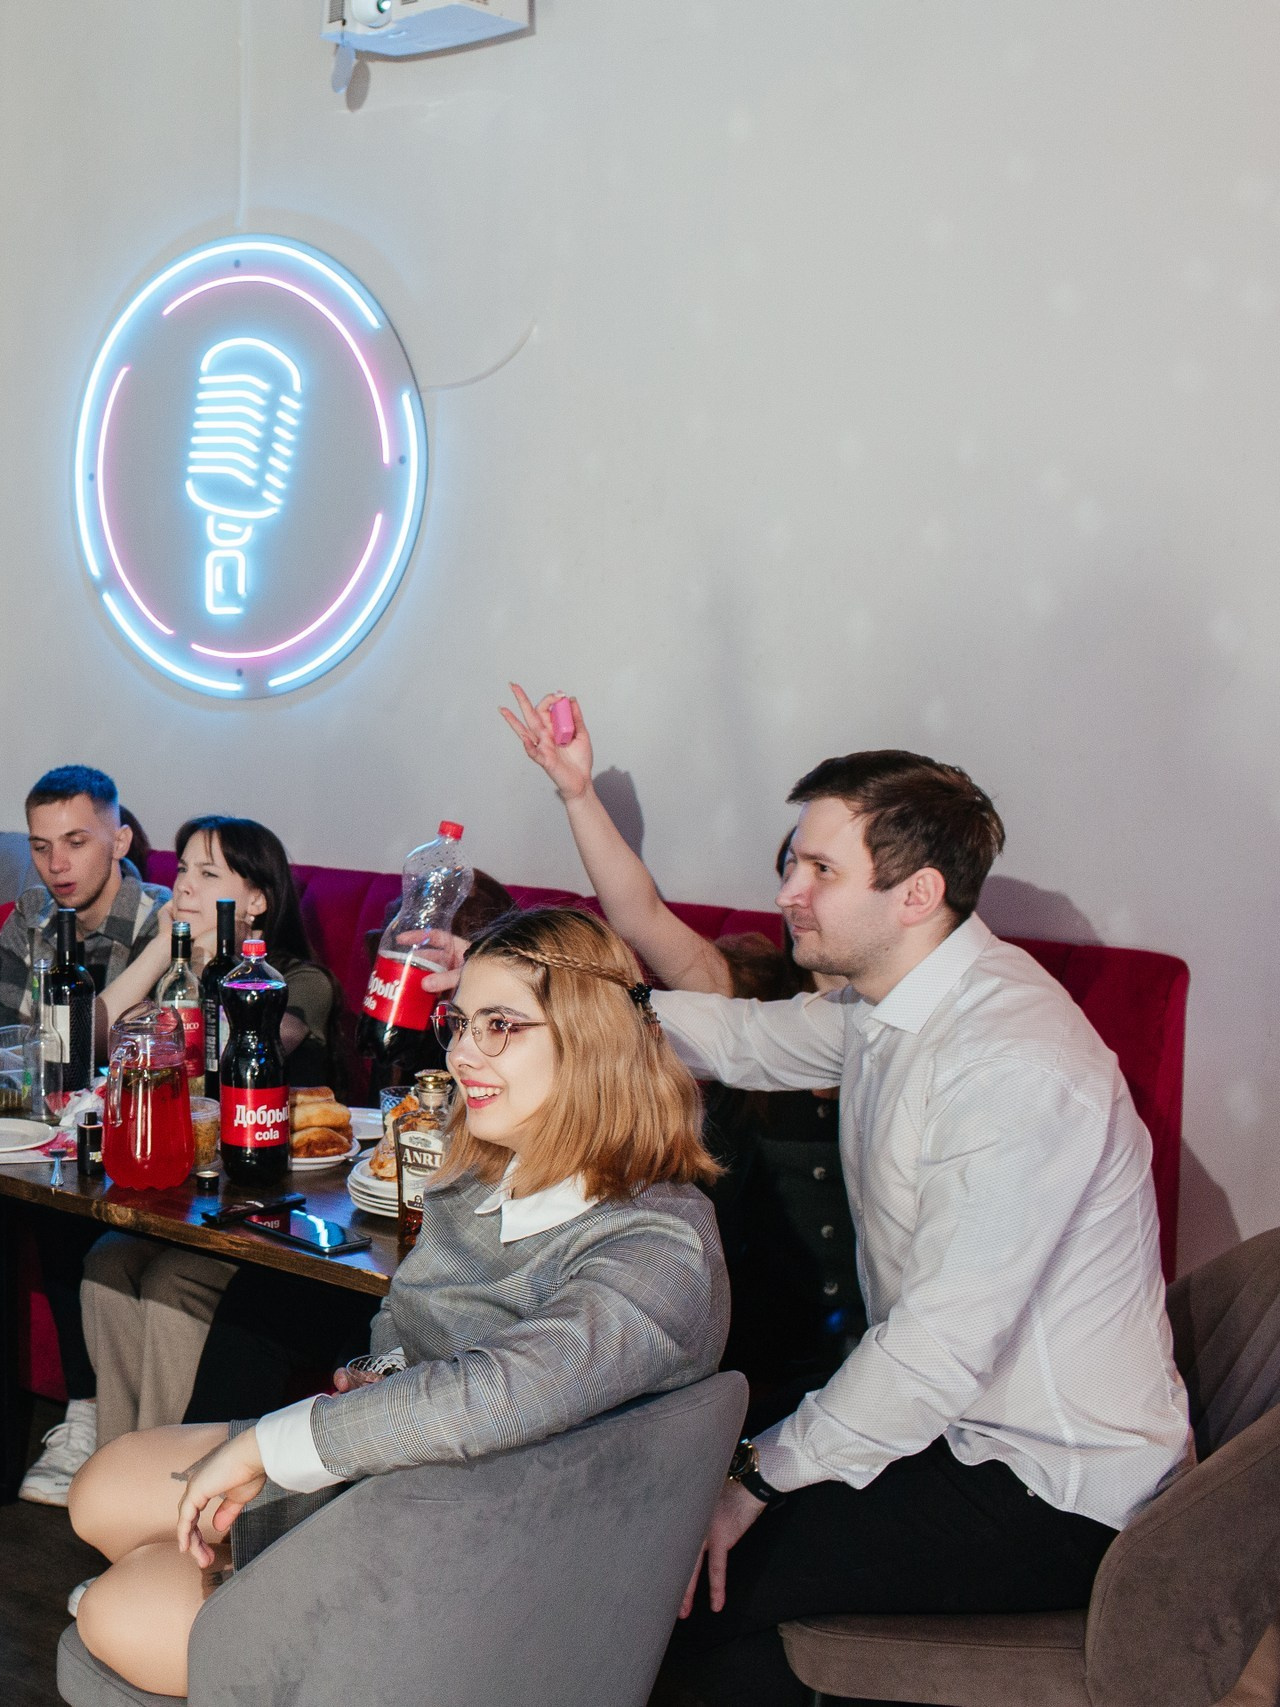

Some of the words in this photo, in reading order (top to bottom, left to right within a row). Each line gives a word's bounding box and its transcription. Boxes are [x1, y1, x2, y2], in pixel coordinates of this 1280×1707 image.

[363, 996, 378, 1011] ola
[255, 1128, 280, 1141] cola
[402, 1148, 442, 1168] ANRI
